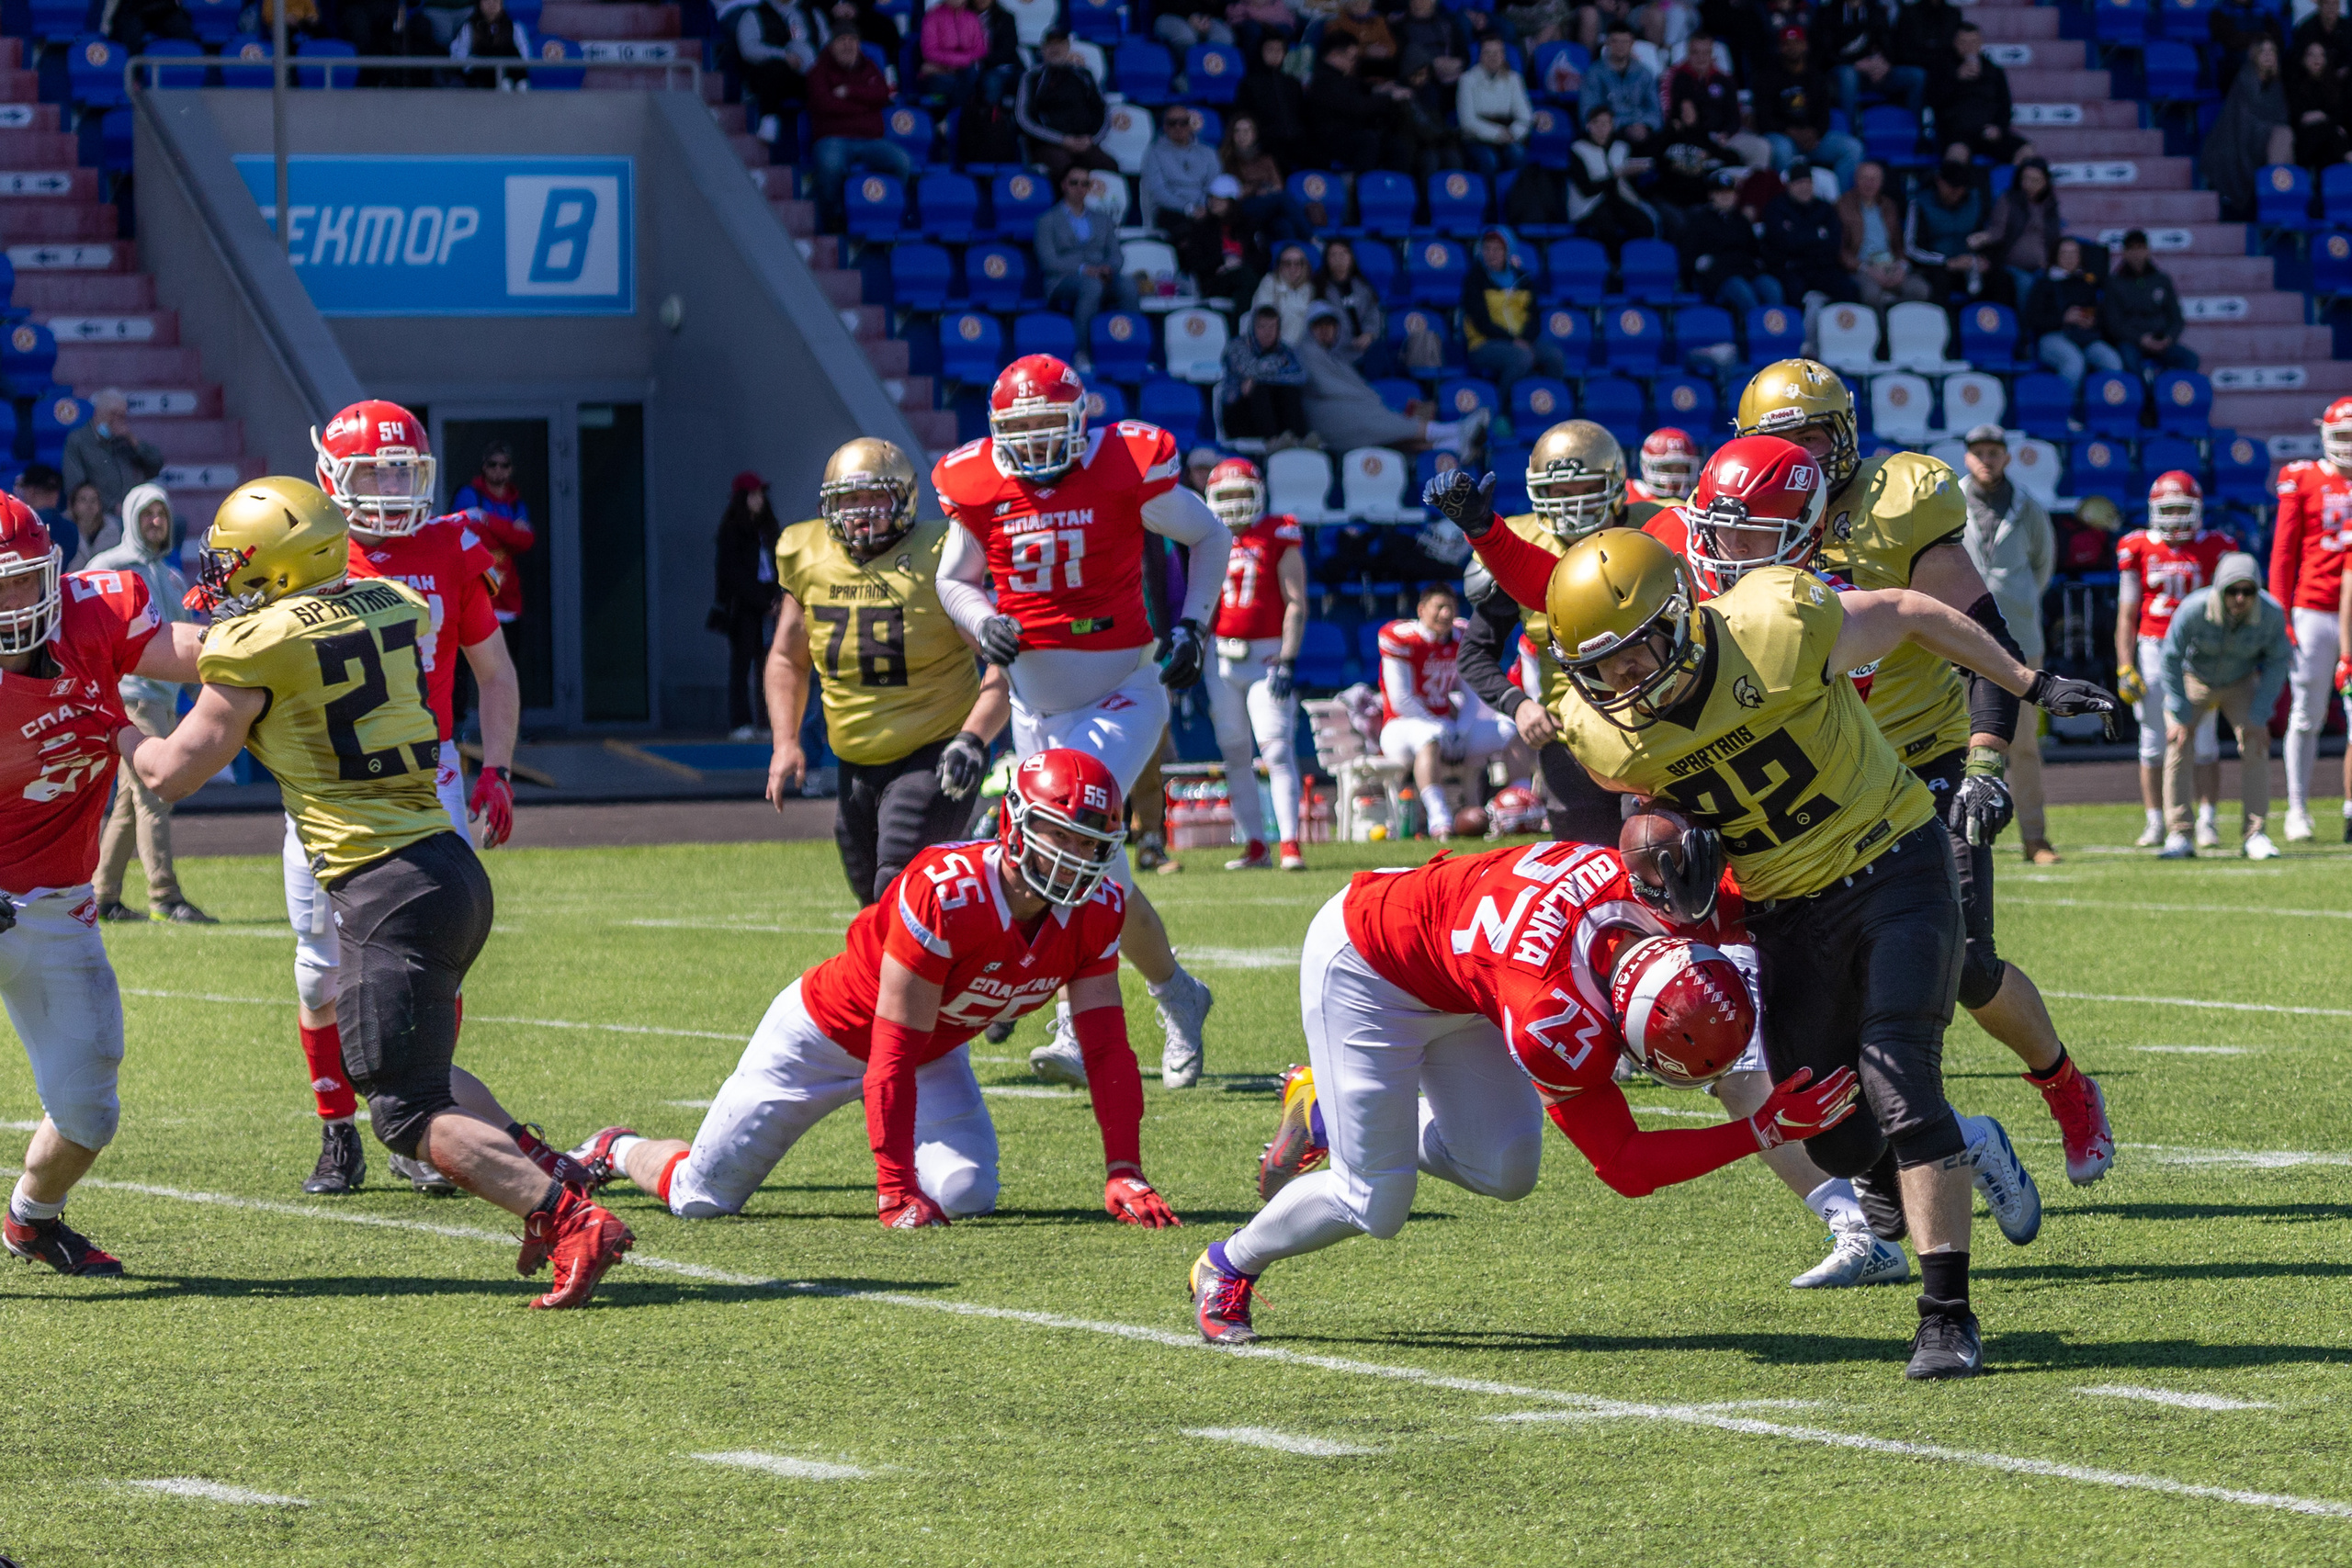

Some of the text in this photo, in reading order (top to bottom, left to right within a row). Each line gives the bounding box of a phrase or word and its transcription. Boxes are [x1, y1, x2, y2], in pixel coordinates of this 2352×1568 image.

[1771, 410, 1794, 421] Riddell
[378, 422, 405, 442] 54
[830, 582, 888, 600] SPARTANS
[289, 585, 404, 627] SPARTANS
[812, 605, 908, 687] 78
[1580, 636, 1612, 653] Riddell
[1665, 725, 1756, 777] SPARTANS
[1083, 784, 1107, 809] 55
[923, 852, 985, 911] 55
[1512, 853, 1619, 967] BURLAKA
[1862, 1256, 1898, 1278] adidas
